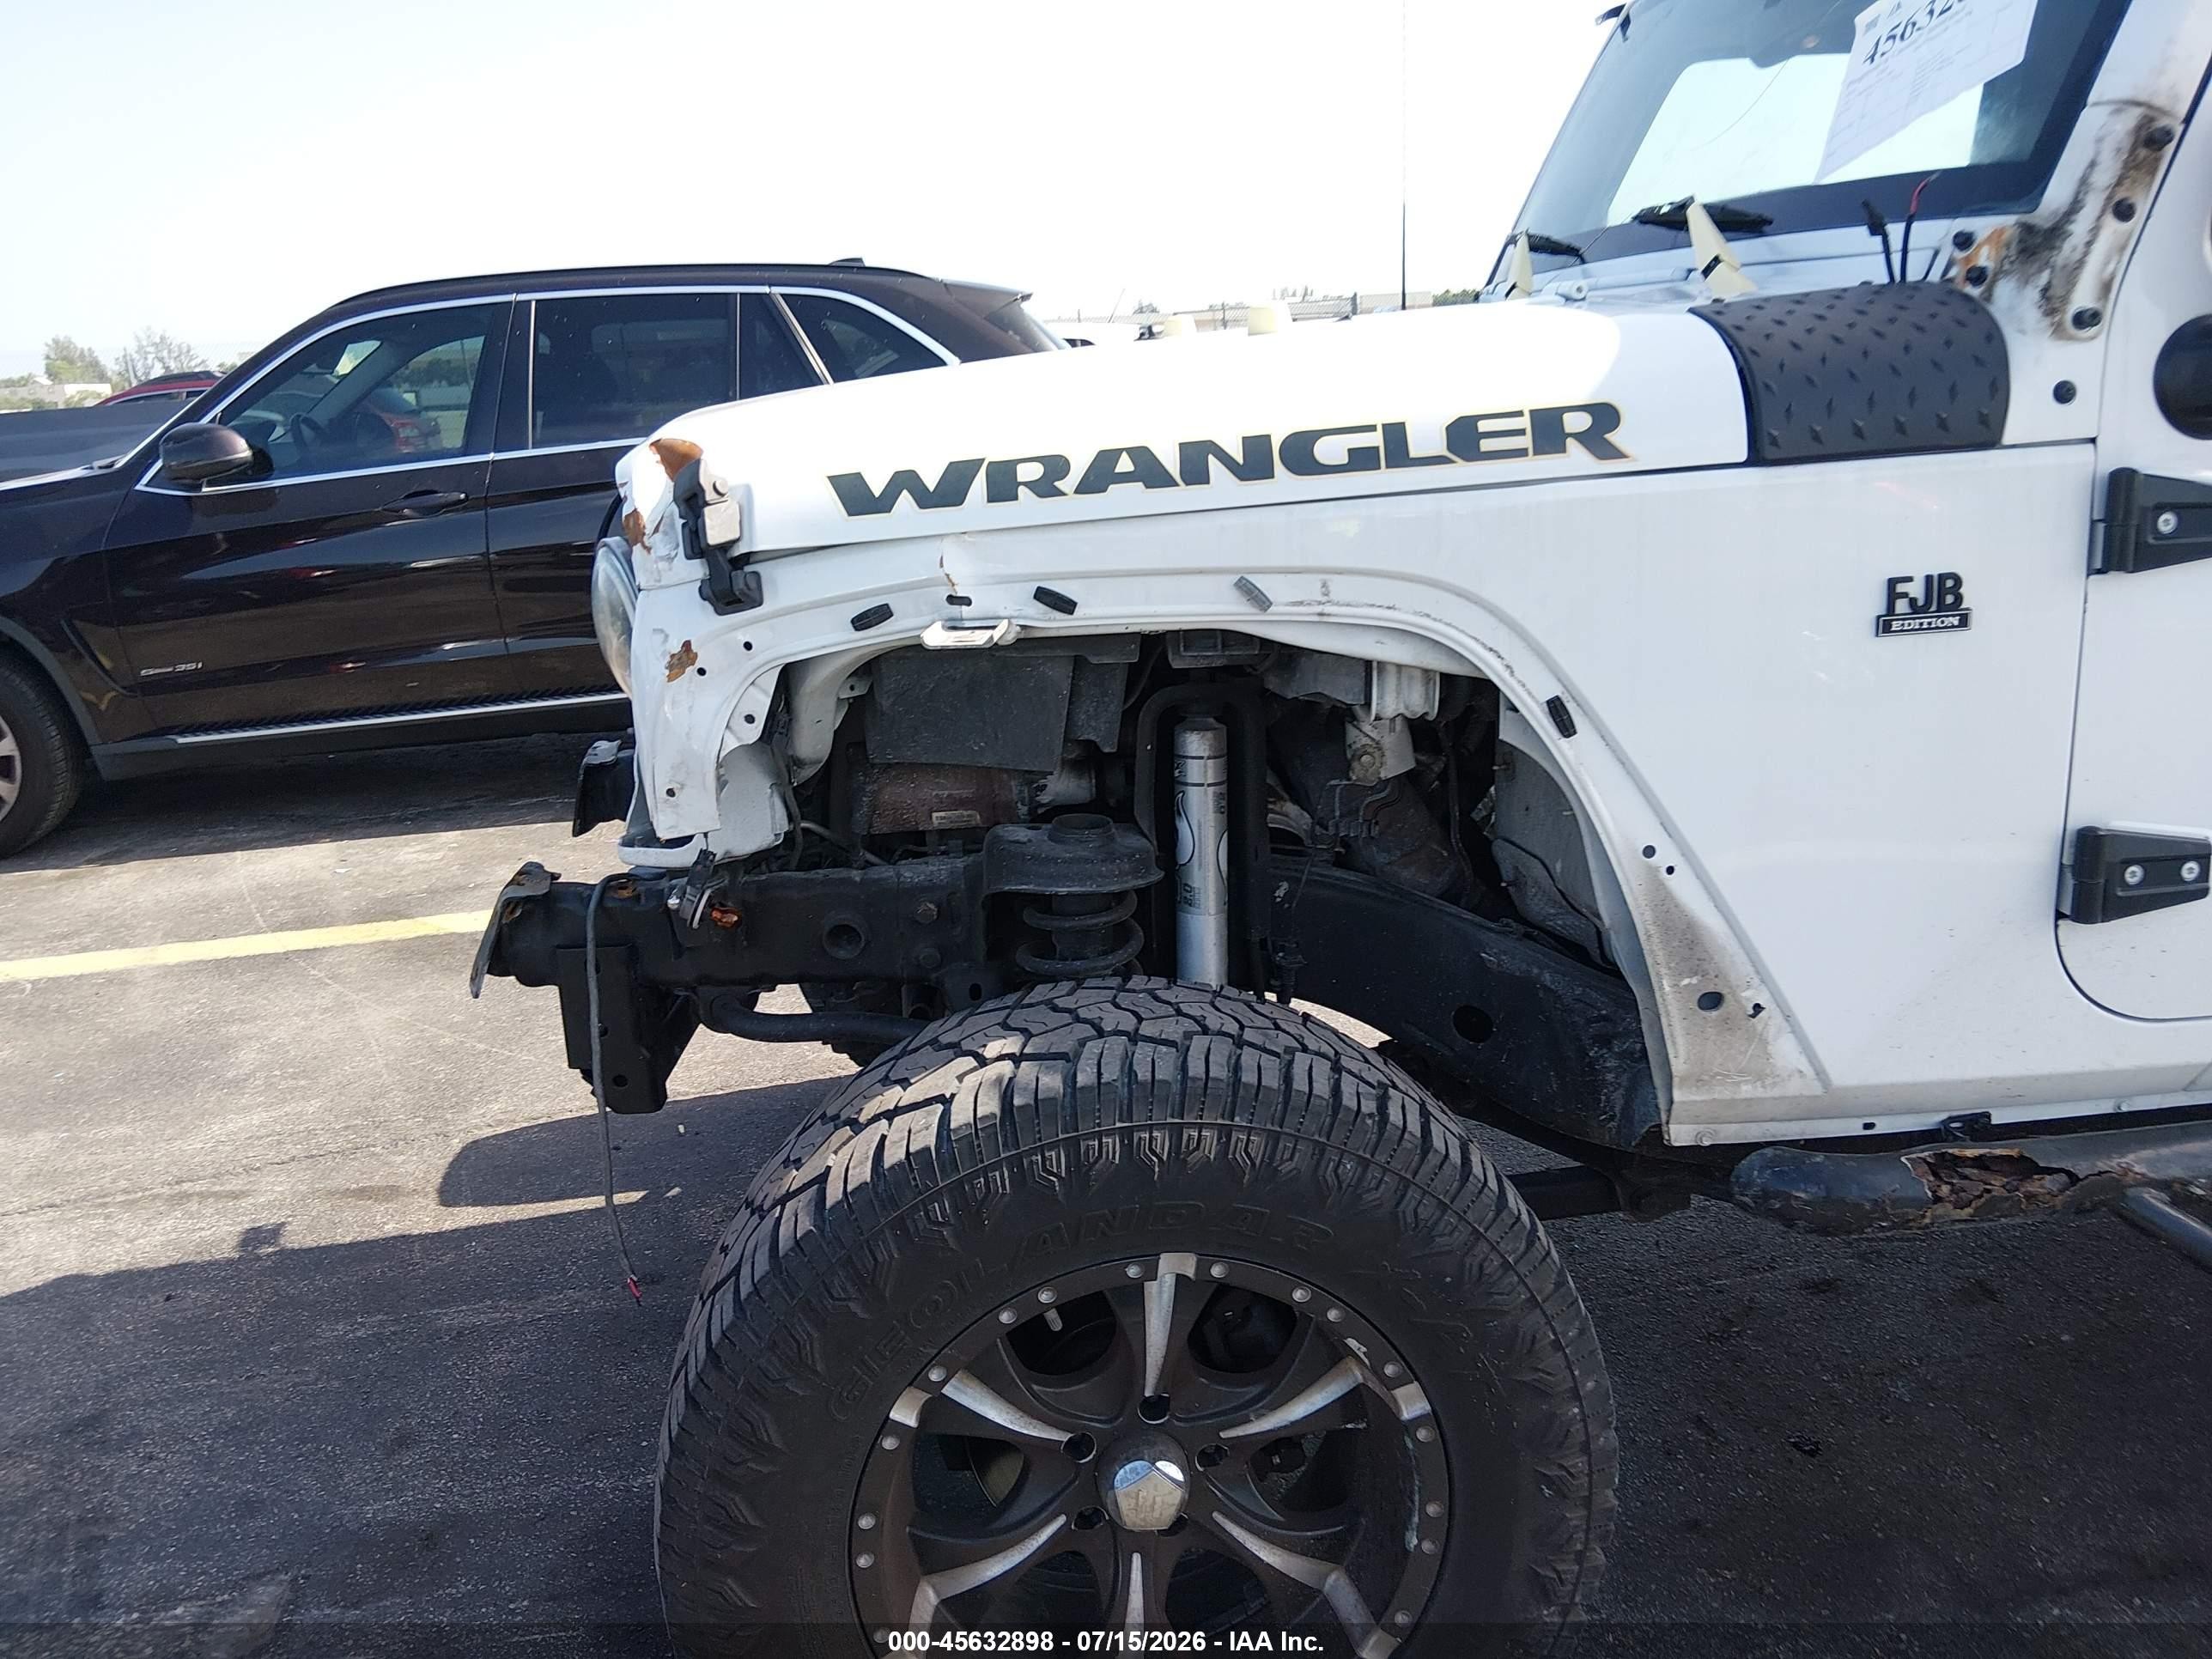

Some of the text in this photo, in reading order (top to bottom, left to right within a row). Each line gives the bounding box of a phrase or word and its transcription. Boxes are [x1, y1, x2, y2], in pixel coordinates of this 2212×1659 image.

[1862, 0, 1964, 65] 45632
[827, 401, 1632, 517] WRANGLER
[1887, 572, 1964, 615] FJB
[1890, 616, 1960, 631] EDITION
